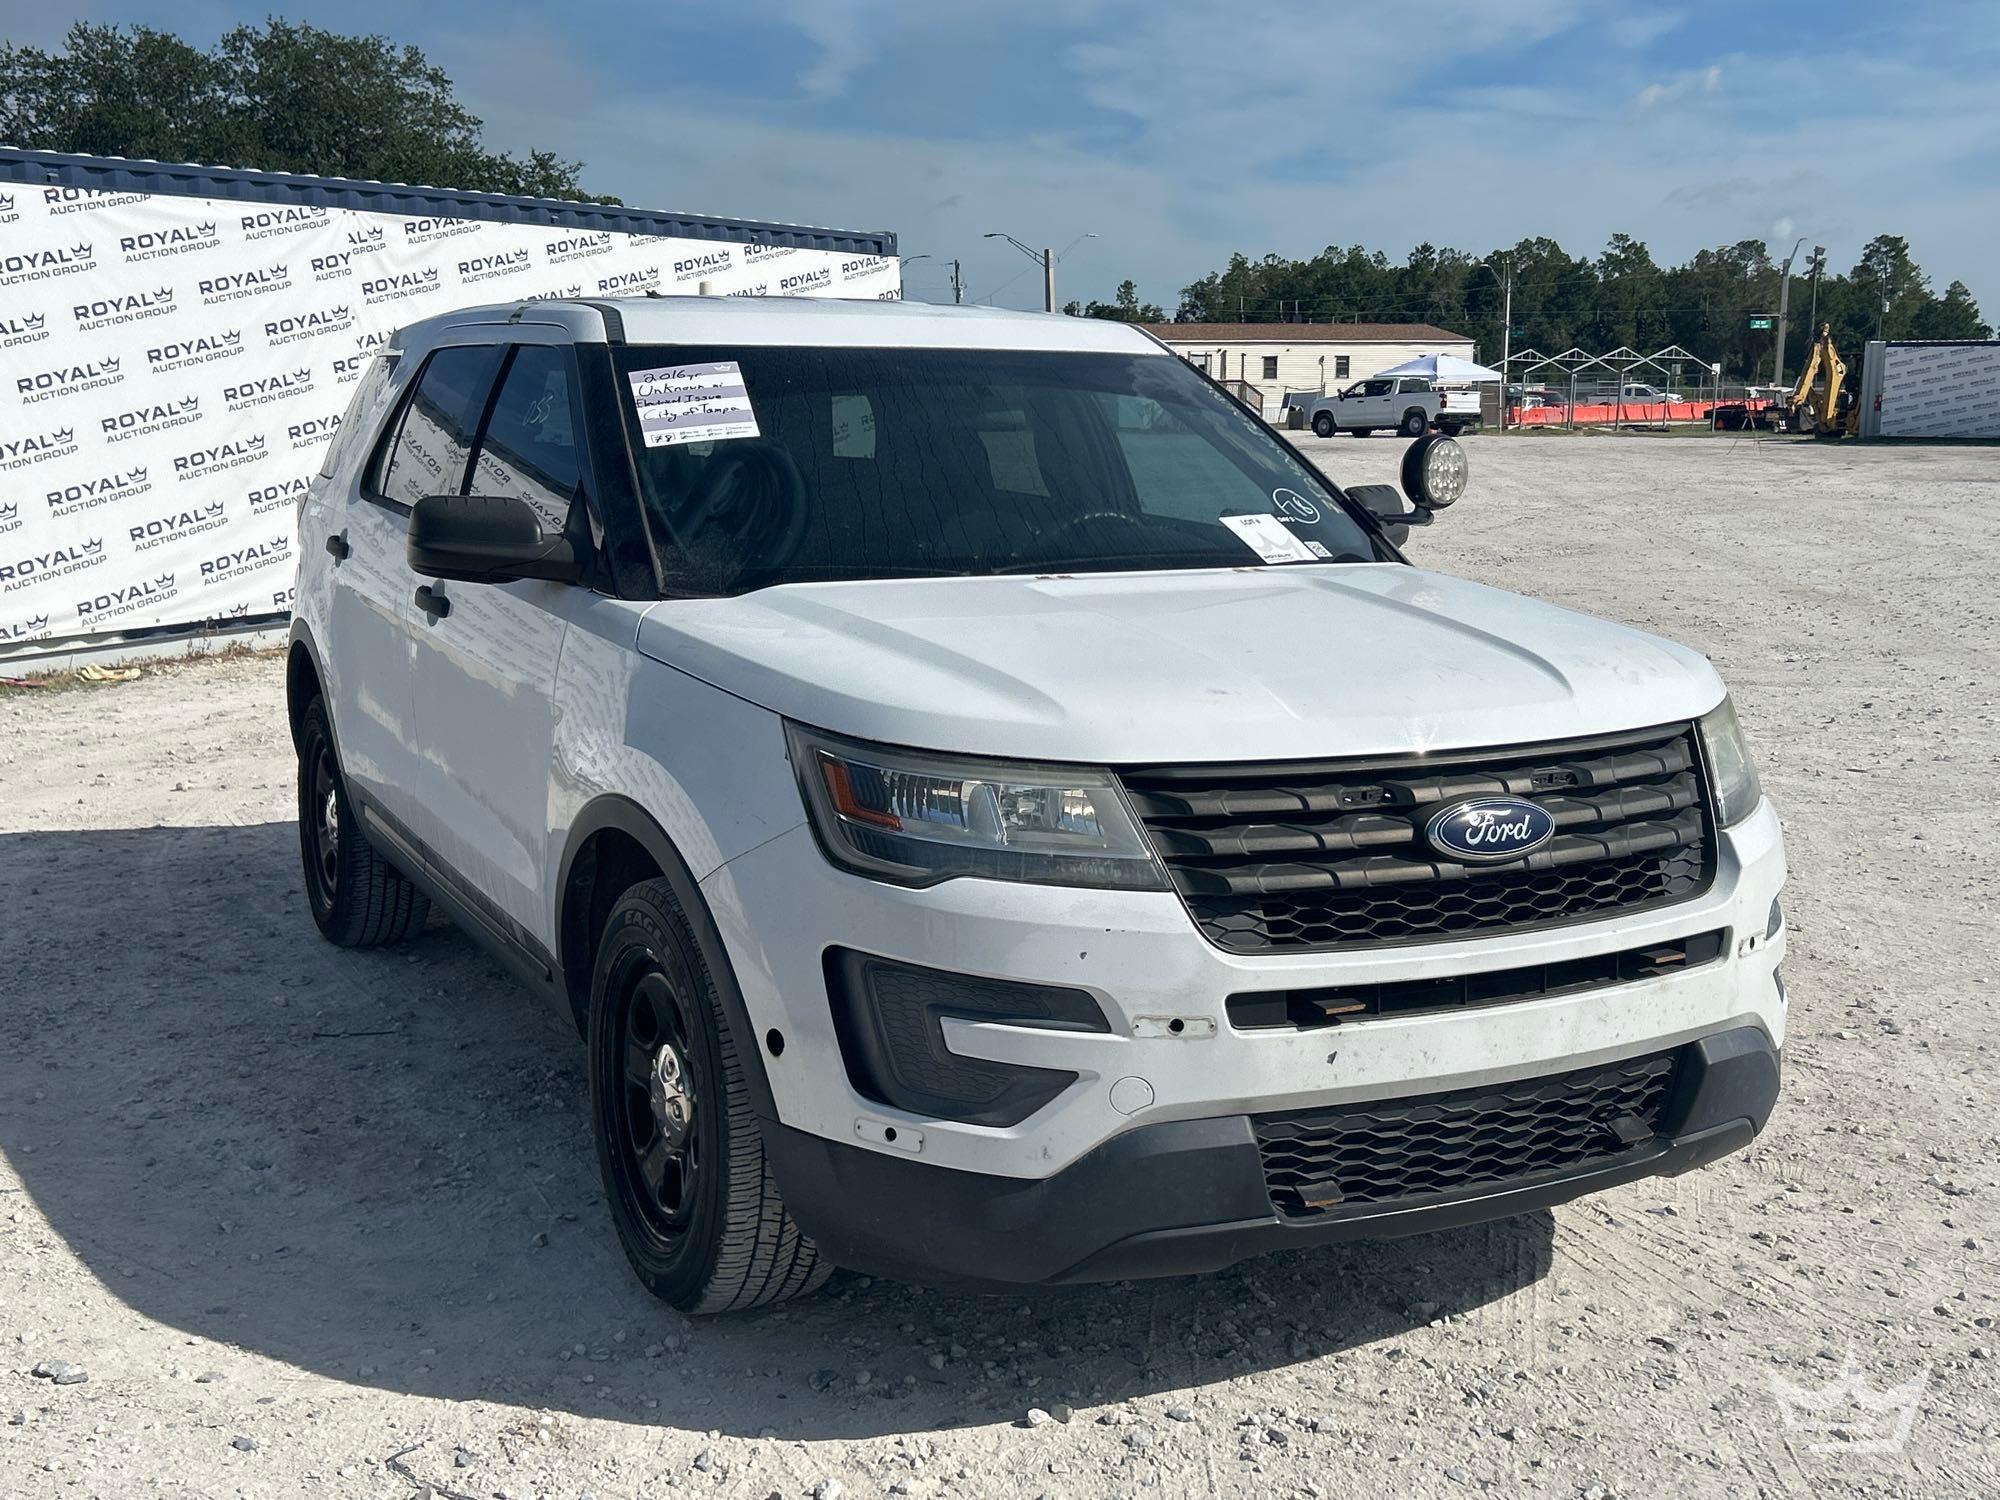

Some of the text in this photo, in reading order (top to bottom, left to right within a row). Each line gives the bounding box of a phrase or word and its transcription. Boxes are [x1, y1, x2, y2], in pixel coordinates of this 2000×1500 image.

[43, 187, 117, 204] ROY
[50, 194, 151, 216] AUCTION GROUP
[241, 208, 310, 230] ROYAL
[245, 218, 330, 241] AUCTION GROUP
[120, 227, 198, 252] ROYAL
[408, 224, 481, 245] AUCTION GROUP
[546, 235, 598, 256] ROYAL
[125, 239, 220, 263] AUCTION GROUP
[352, 242, 387, 255] GROUP
[549, 246, 613, 265] AUCTION GROUP
[743, 244, 780, 257] ROY
[0, 249, 73, 275] OYAL
[0, 262, 97, 287] UCTION GROUP
[311, 252, 351, 272] ROY
[458, 253, 515, 275] ROYAL
[461, 263, 532, 284] AUCTION GROUP
[674, 254, 719, 274] ROYAL
[842, 256, 880, 273] ROYAL
[199, 269, 271, 295] ROYAL
[315, 268, 352, 282] AUCTIO
[362, 272, 423, 295] ROYAL
[598, 271, 647, 292] ROYAL
[780, 271, 820, 290] ROYAL
[203, 281, 292, 306] AUCTION GROUP
[366, 283, 441, 306] AUCTION GROUP
[521, 289, 564, 300] YAL
[879, 288, 901, 300] ROY
[73, 292, 155, 321] ROYAL
[79, 305, 178, 332] AUCTION GROUP
[265, 311, 333, 336] ROYAL
[269, 321, 352, 347] AUCTION GROUP
[3, 331, 50, 347] GROUP
[147, 336, 223, 364] ROYAL
[356, 331, 385, 349] YAL
[152, 346, 245, 375] AUCTION GROUP
[17, 363, 101, 394] ROYAL
[22, 374, 125, 406] AUCTION GROUP
[223, 374, 294, 402] ROYAL
[228, 384, 314, 413] AUCTION GROUP
[101, 403, 181, 432] ROYAL
[643, 403, 740, 422] City of Tampa
[107, 413, 203, 444] AUCTION GROUP
[288, 413, 343, 440] ROYA
[0, 435, 54, 460] YAL
[0, 445, 78, 471] TION GROUP
[173, 441, 247, 471] ROYAL
[179, 450, 269, 482] AUCTION GROUP
[46, 474, 129, 507] ROYAL
[52, 483, 152, 518] AUCTION GROUP
[130, 510, 206, 542] ROYAL
[135, 517, 228, 552] AUCTION GROUP
[0, 547, 83, 583] ROYAL
[200, 544, 271, 576] ROYAL
[204, 551, 292, 586] AUCTION GROUP
[4, 554, 107, 593] AUCTION GROUP
[77, 582, 156, 616] ROYAL
[81, 588, 178, 628] AUCTION GROUP
[1465, 808, 1532, 846] Ford
